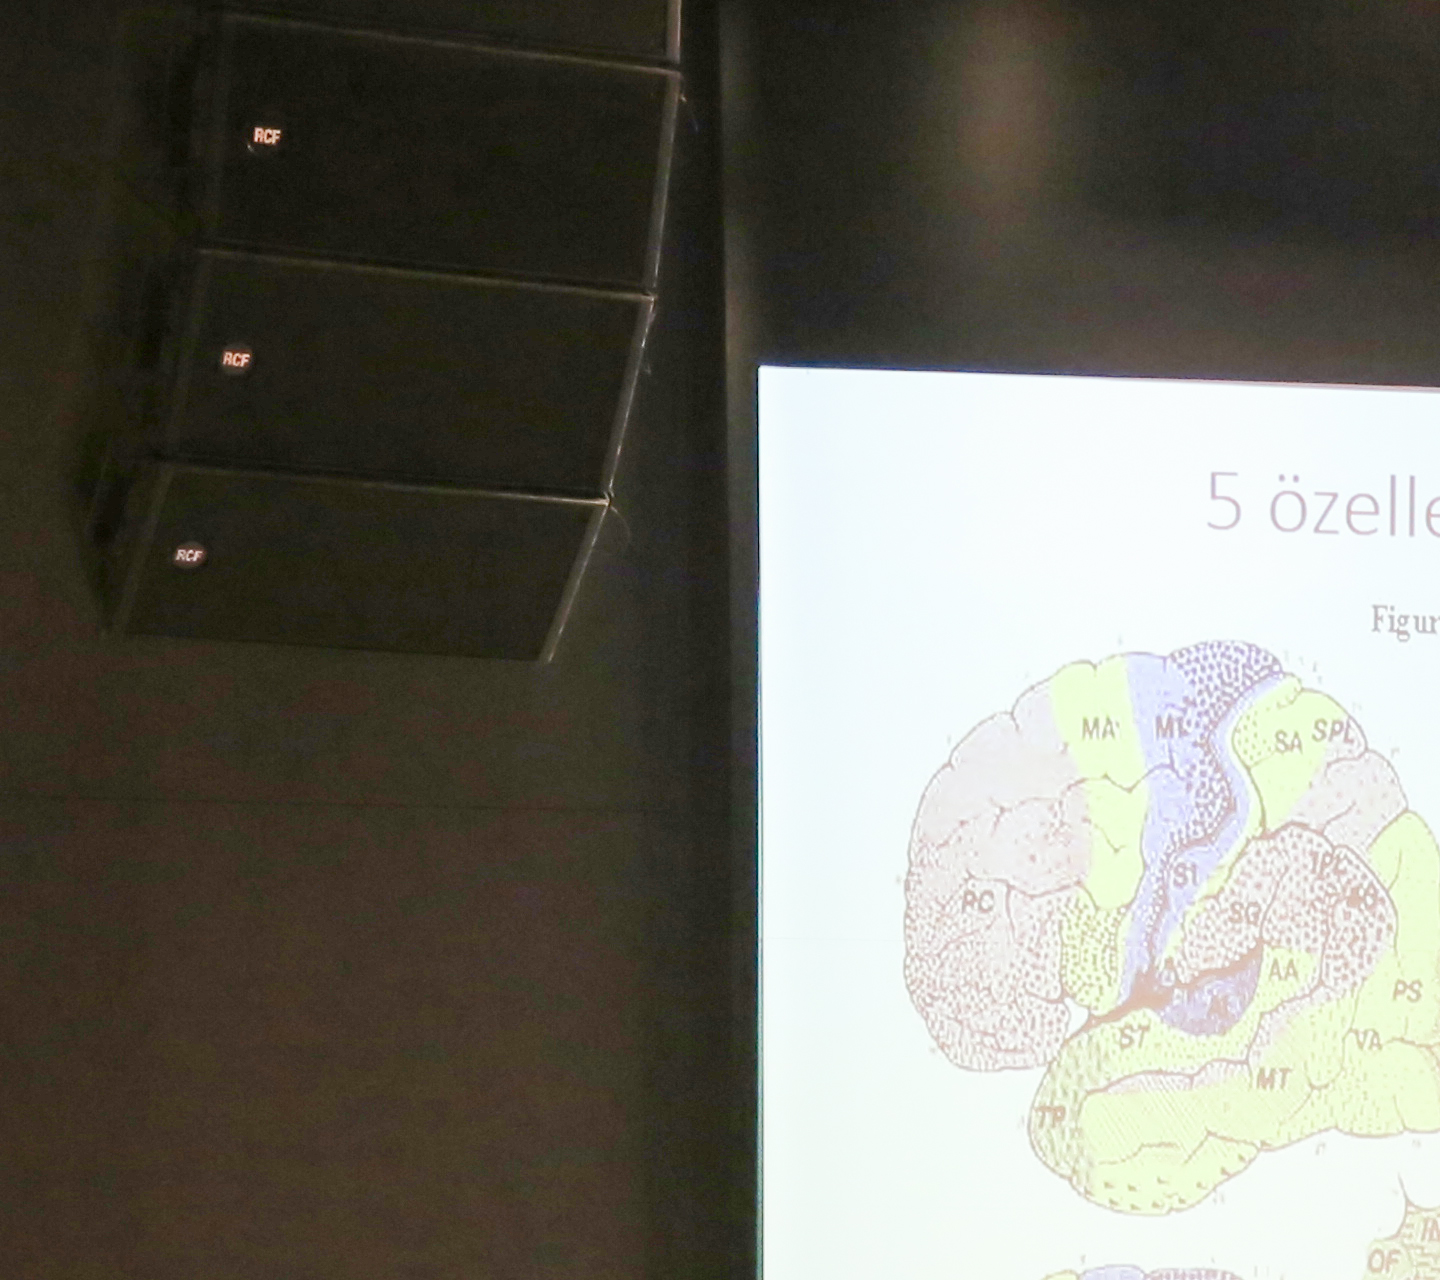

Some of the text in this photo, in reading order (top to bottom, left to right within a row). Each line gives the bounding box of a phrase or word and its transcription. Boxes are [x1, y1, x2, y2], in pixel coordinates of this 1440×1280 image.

[254, 127, 281, 146] RCF
[222, 351, 251, 368] RCF
[1207, 471, 1242, 530] 5
[175, 548, 203, 562] RCF
